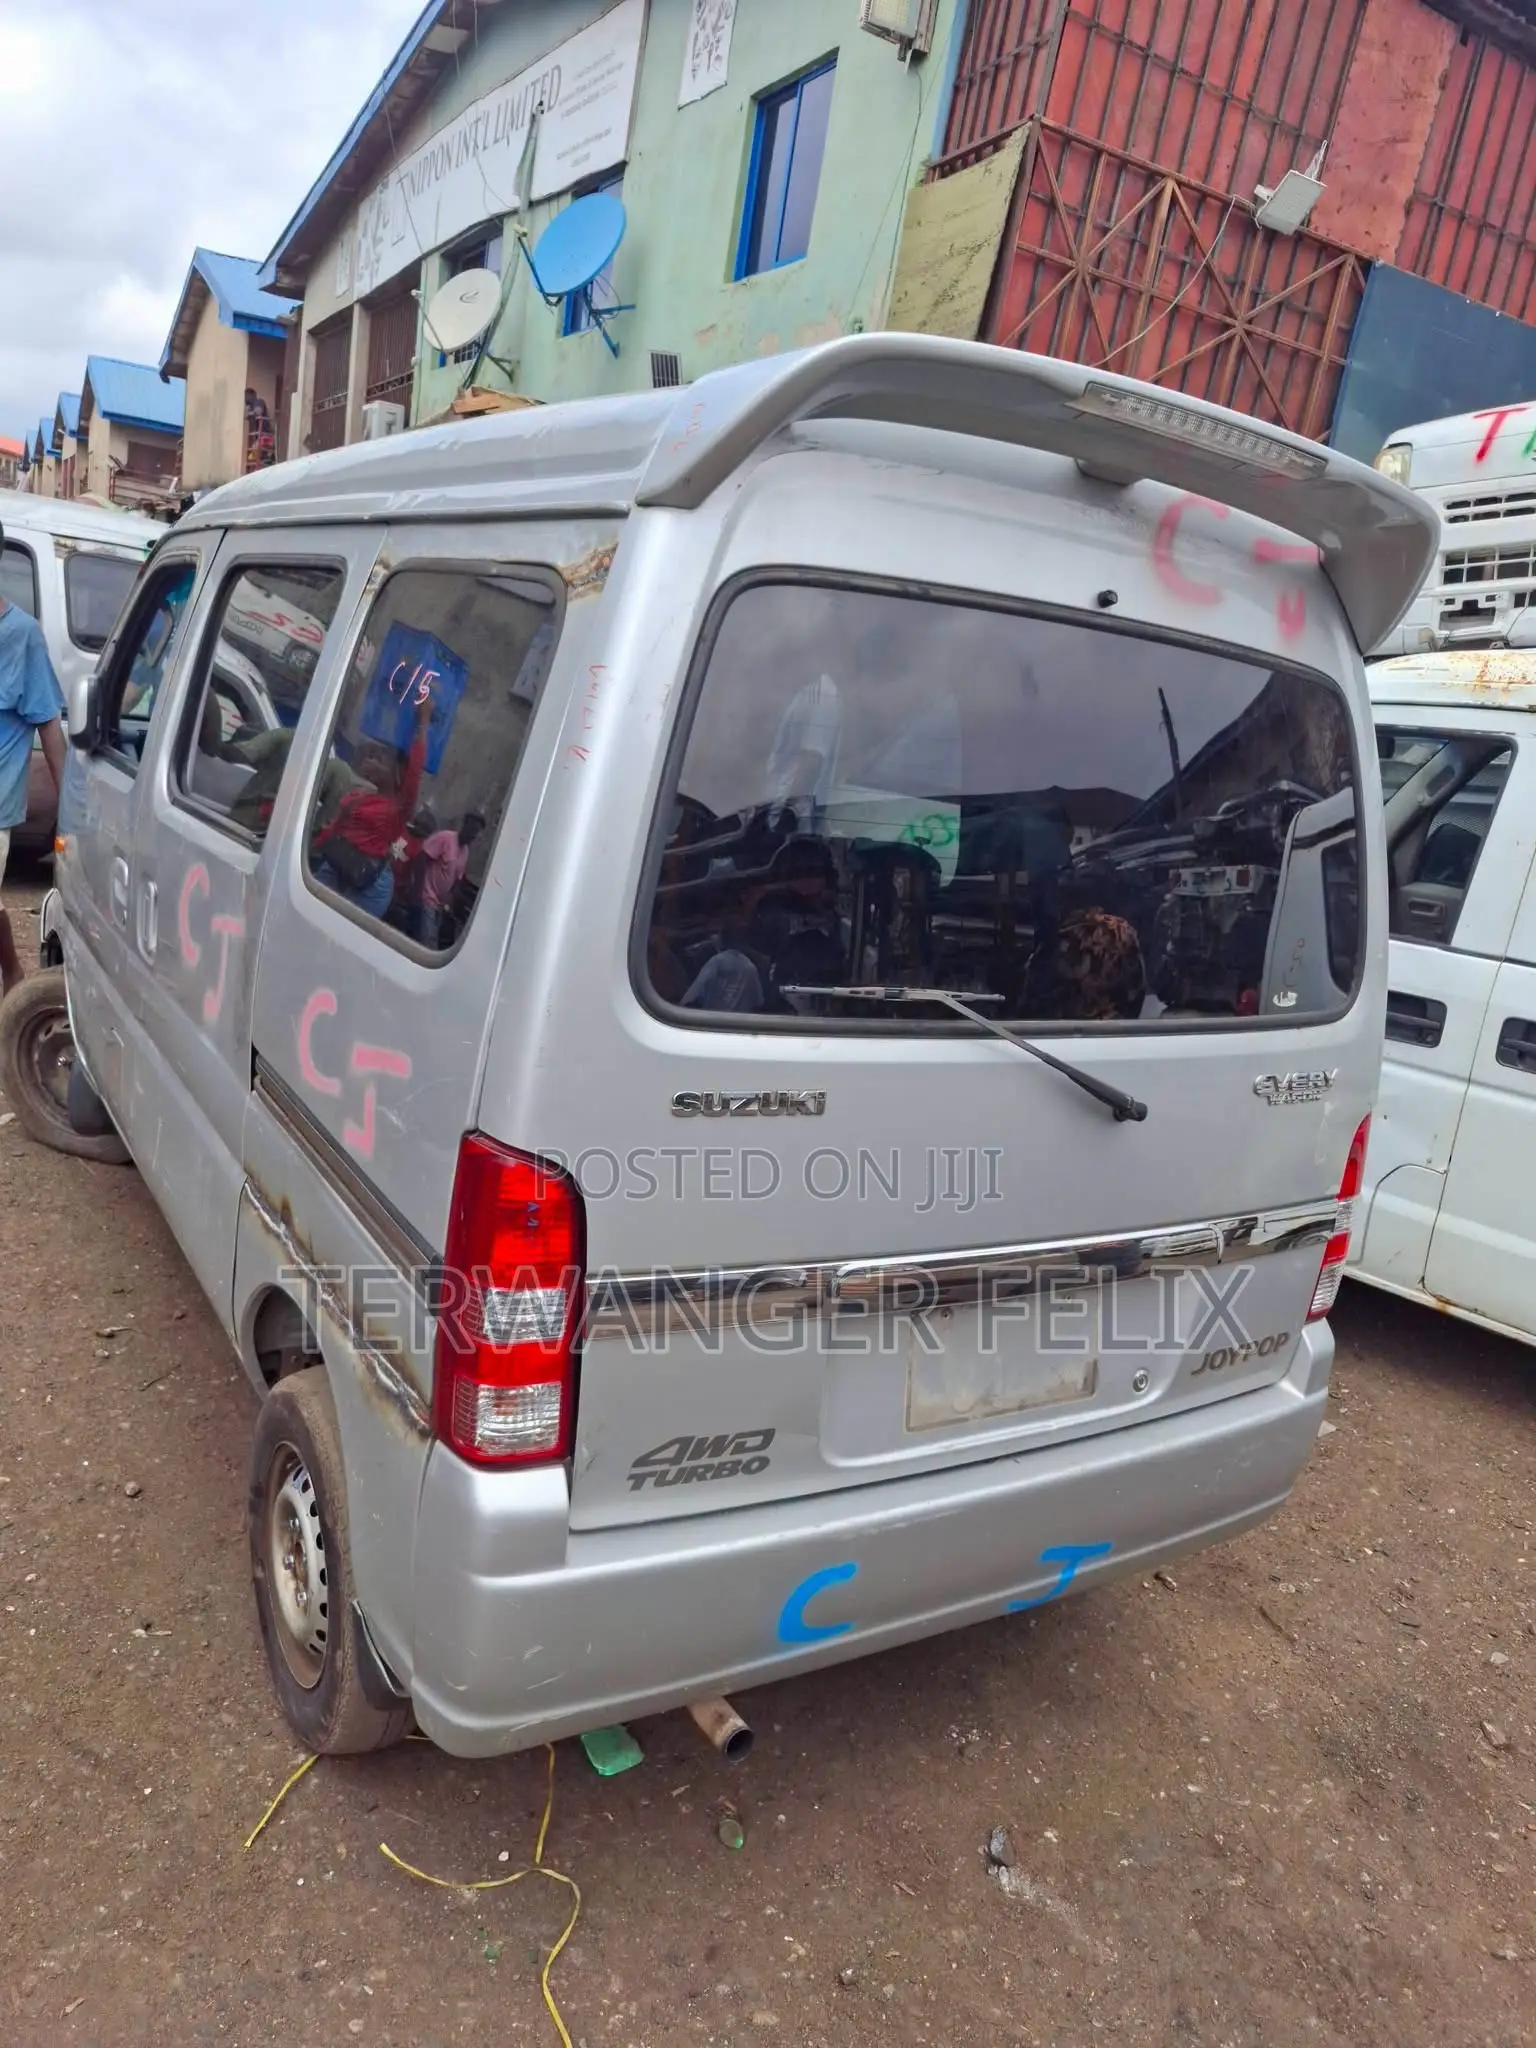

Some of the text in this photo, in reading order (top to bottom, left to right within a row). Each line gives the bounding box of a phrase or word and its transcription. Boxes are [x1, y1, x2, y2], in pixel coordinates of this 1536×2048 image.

[493, 64, 562, 145] LIMITED
[671, 1089, 827, 1117] SUZUKI
[627, 1455, 771, 1493] TURBO
